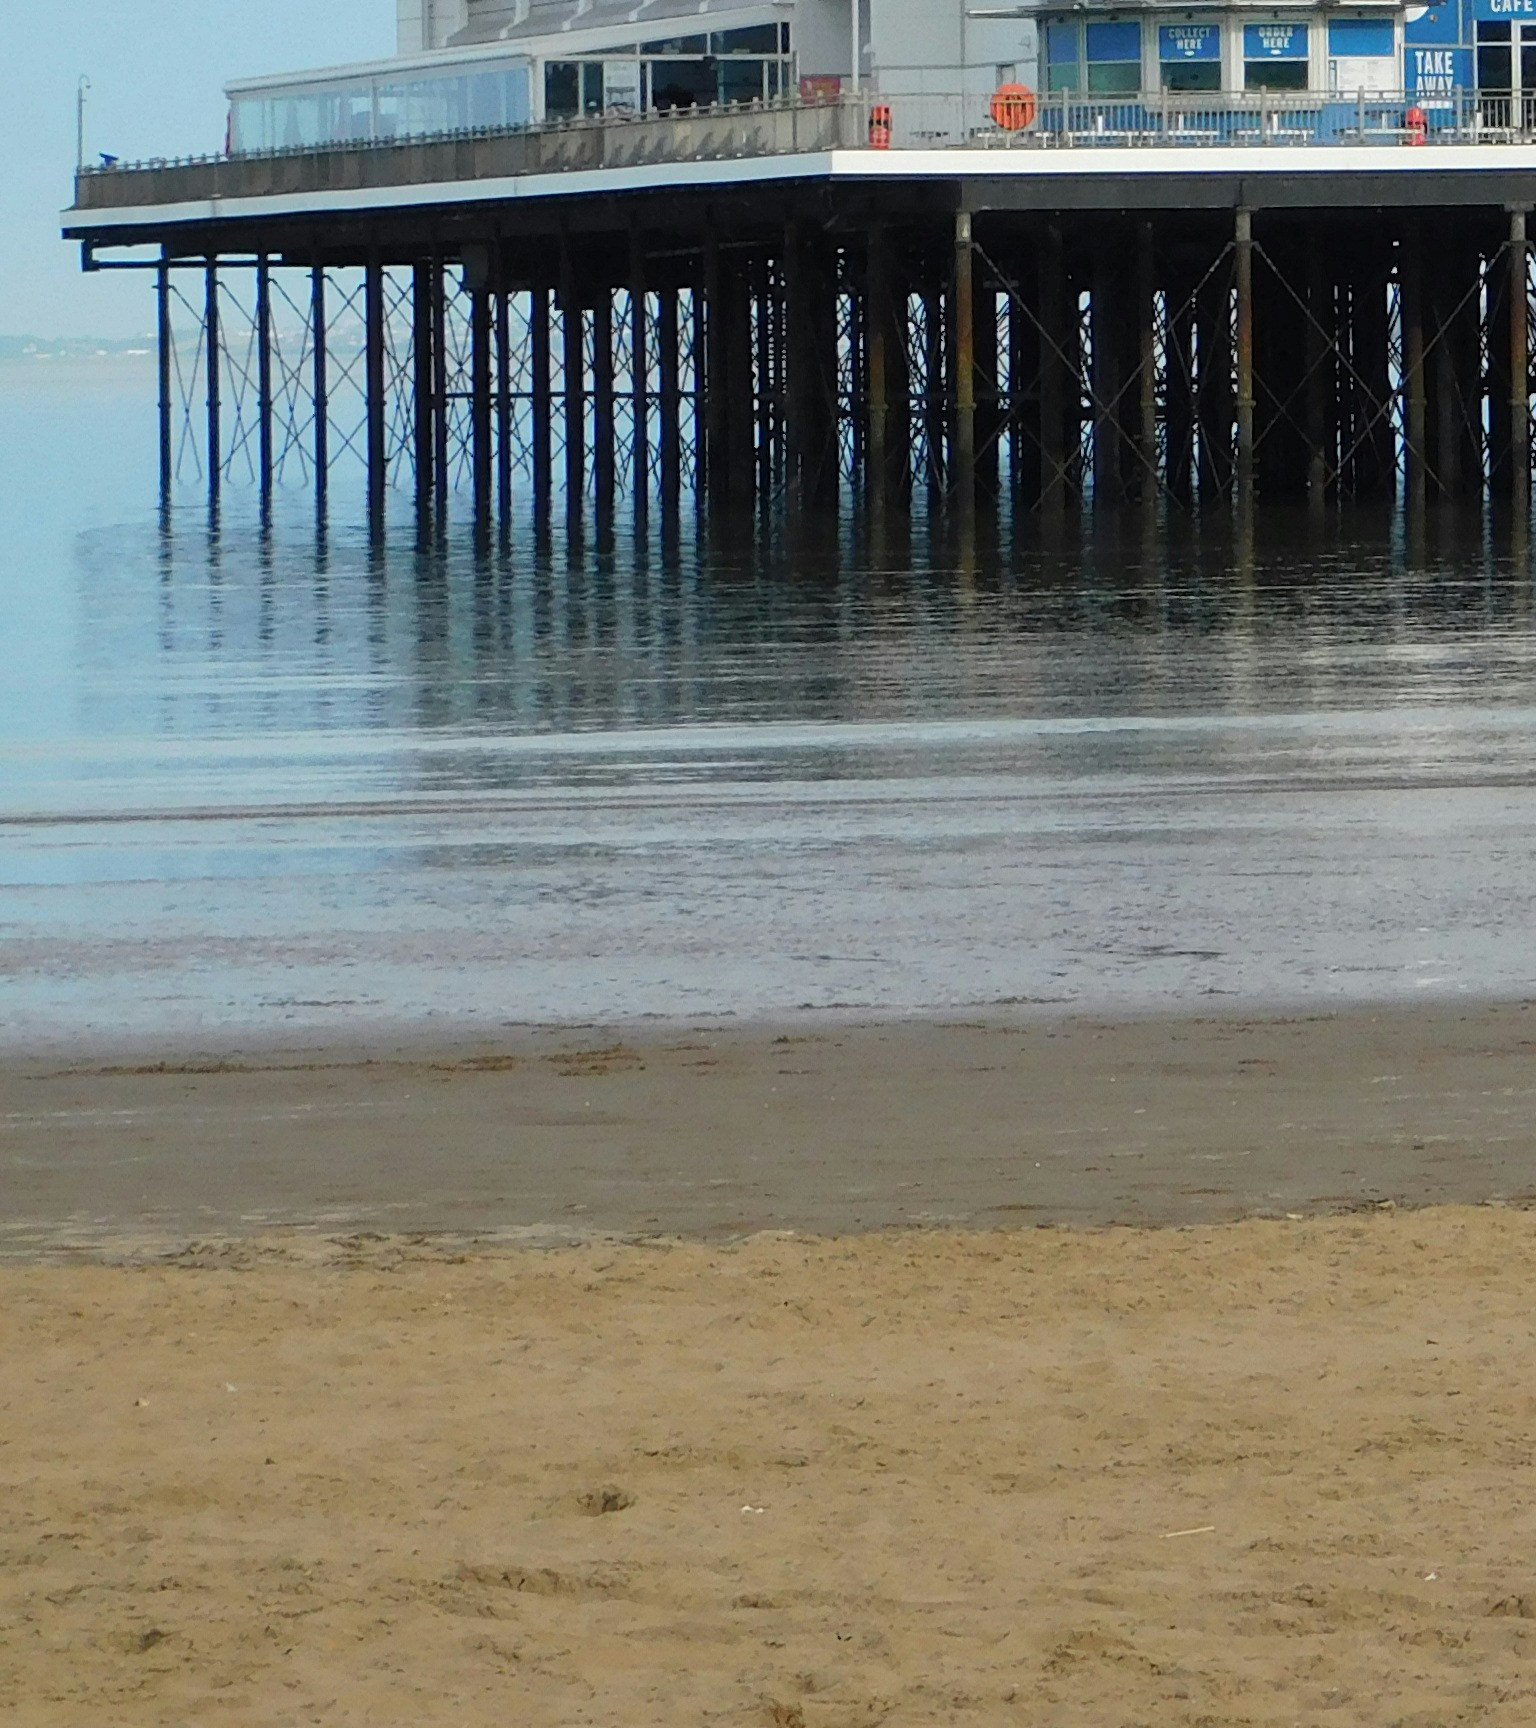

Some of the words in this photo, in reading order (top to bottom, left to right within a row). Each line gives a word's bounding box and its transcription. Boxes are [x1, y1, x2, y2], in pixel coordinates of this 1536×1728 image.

[1168, 27, 1211, 39] COLLECT
[1258, 26, 1293, 38] ORDER
[1176, 38, 1203, 50] HERE
[1262, 37, 1290, 49] HERE
[1415, 51, 1454, 75] TAKE
[1416, 75, 1454, 97] AWAY
